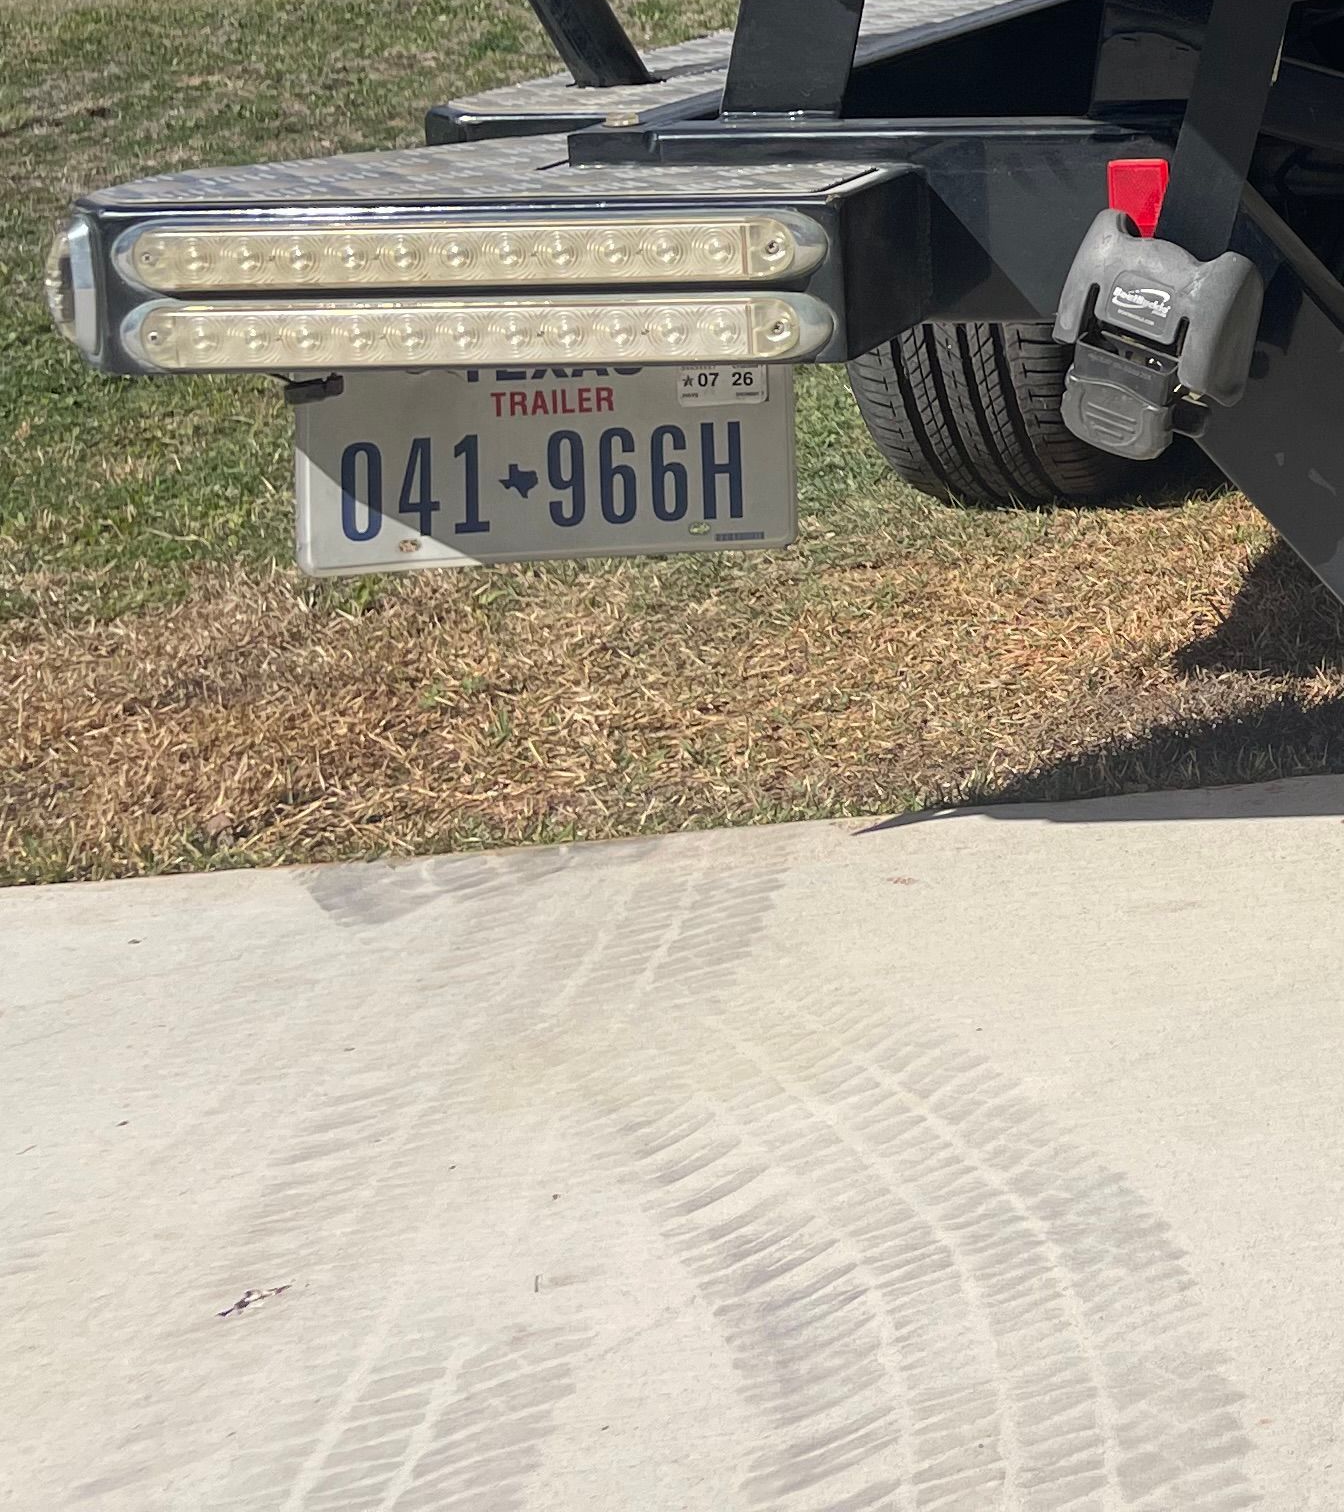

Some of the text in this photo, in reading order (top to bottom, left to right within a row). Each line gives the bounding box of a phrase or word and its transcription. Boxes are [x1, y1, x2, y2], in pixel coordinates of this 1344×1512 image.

[697, 371, 754, 387] 07 26
[490, 387, 615, 417] TRAILER
[340, 421, 743, 541] 041 966H
